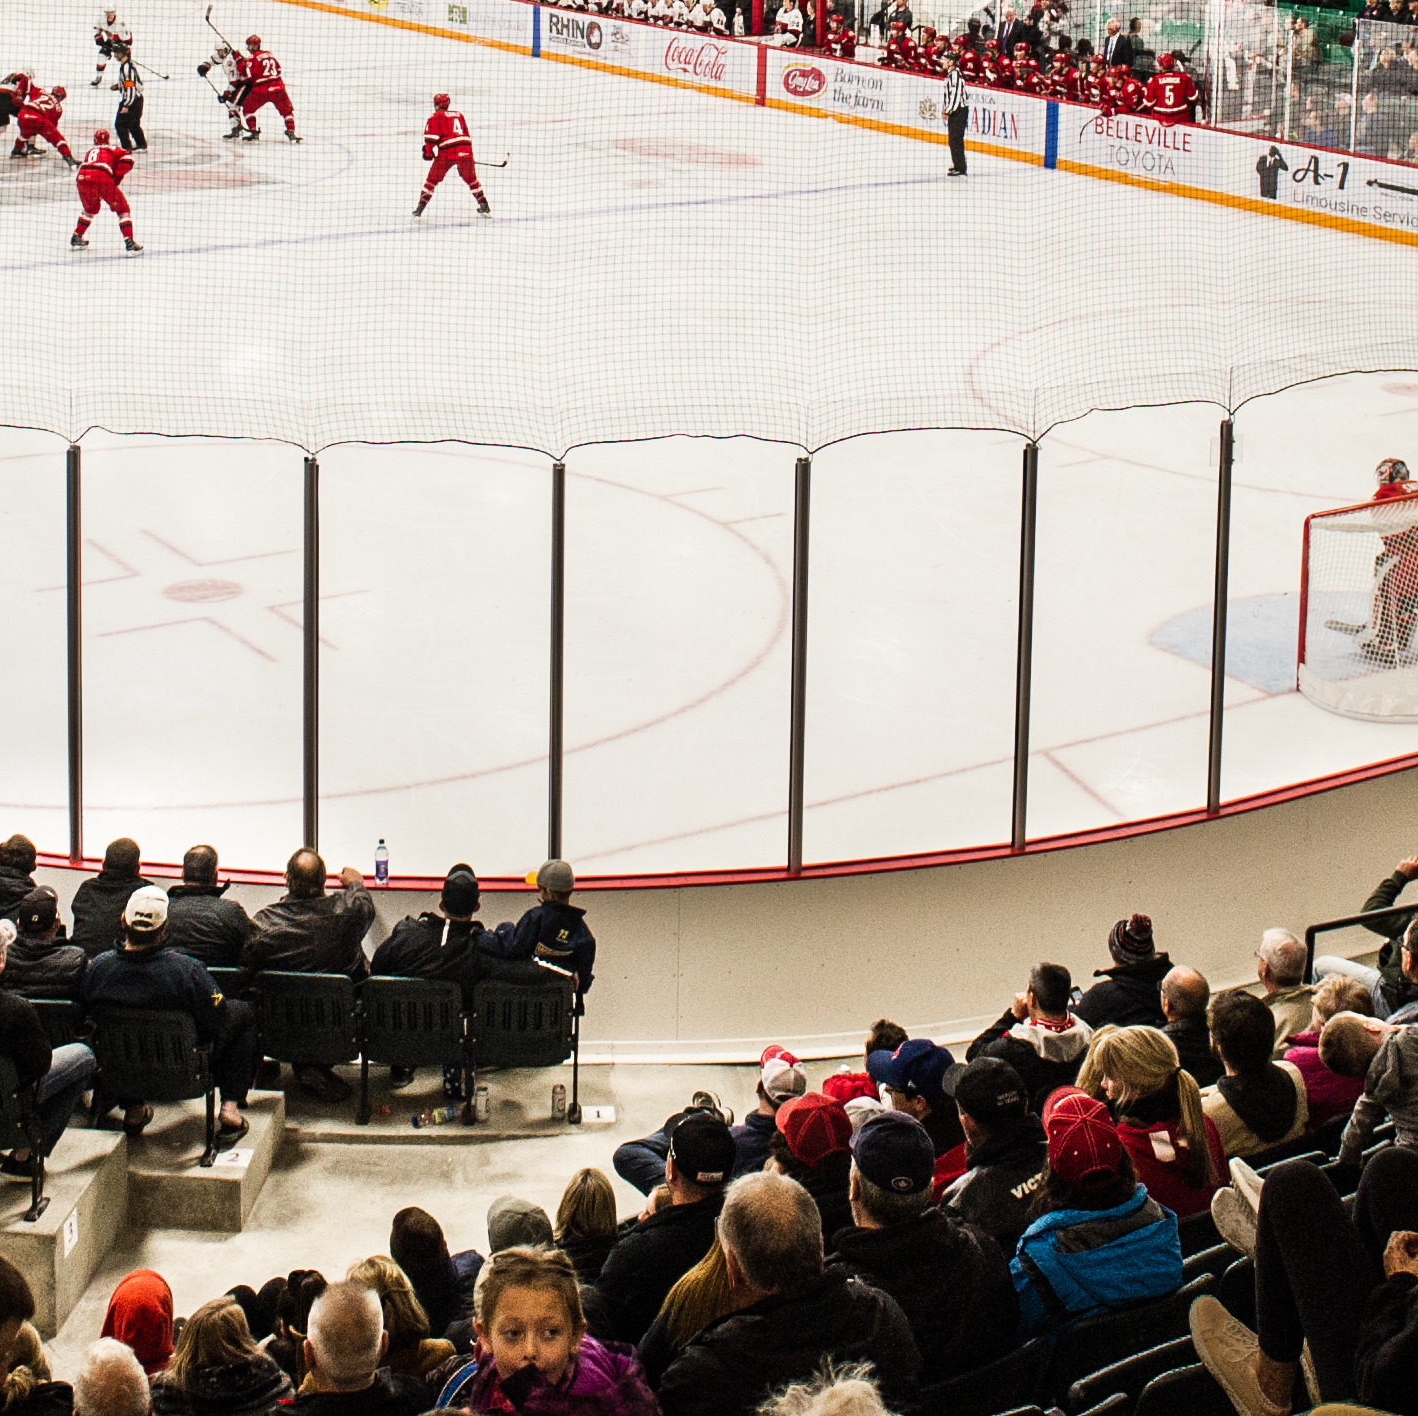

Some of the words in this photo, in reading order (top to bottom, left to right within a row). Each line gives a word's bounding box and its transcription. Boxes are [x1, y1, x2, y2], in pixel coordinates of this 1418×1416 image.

[549, 12, 603, 50] RHINO
[262, 59, 278, 76] 23
[665, 36, 728, 81] Coca-Cola
[834, 67, 865, 88] Born
[868, 77, 883, 91] on
[833, 86, 851, 104] the
[851, 89, 884, 111] farm
[1165, 85, 1174, 105] 5
[453, 118, 464, 135] 4
[1094, 115, 1193, 153] BELLEVILLE
[1109, 143, 1176, 177] TOYOTA
[1292, 154, 1350, 190] A-1
[1292, 188, 1369, 218] Limousine
[227, 1152, 240, 1162] 2
